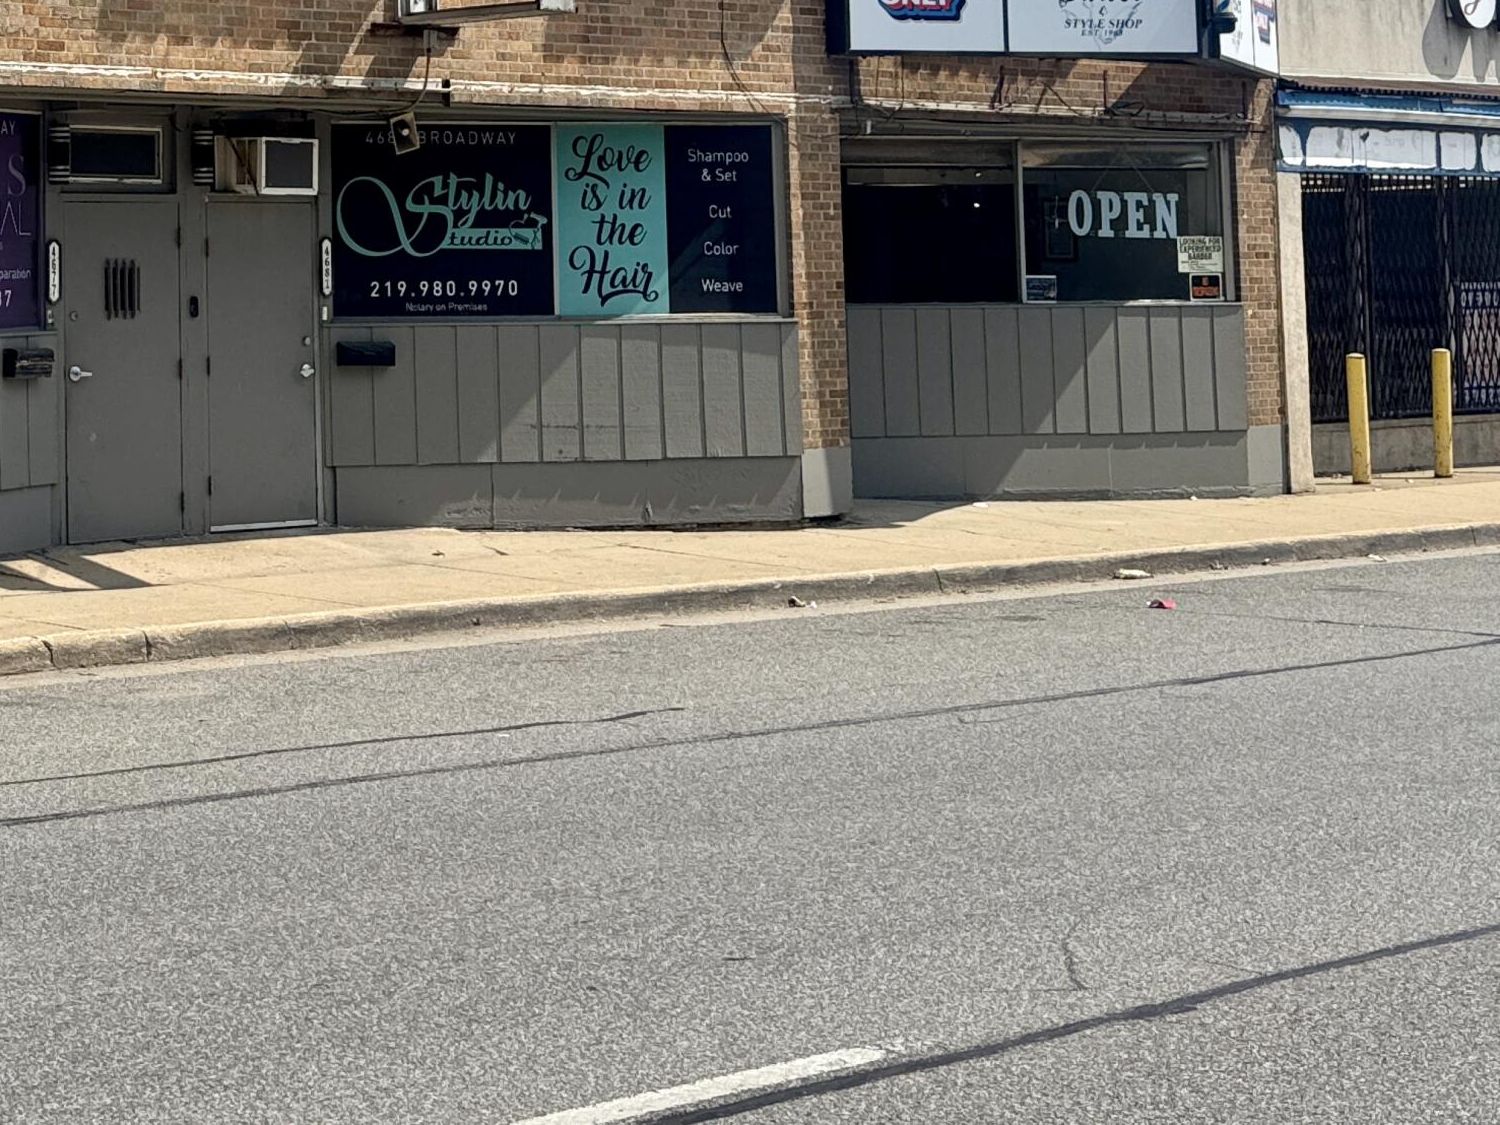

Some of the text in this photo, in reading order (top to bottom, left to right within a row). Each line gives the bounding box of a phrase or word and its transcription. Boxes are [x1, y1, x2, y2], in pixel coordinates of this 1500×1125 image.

[1064, 18, 1143, 29] STYLE SHOP
[366, 130, 516, 145] 468 BROADWAY
[565, 133, 652, 190] Love
[687, 148, 749, 165] Shampoo
[701, 168, 738, 182] & Set
[581, 183, 652, 211] is in
[708, 204, 733, 219] Cut
[1067, 189, 1179, 239] OPEN
[592, 213, 648, 246] the
[703, 241, 739, 255] Color
[569, 245, 659, 308] Hair
[701, 278, 743, 292] Weave
[370, 280, 518, 297] 219.980.9970
